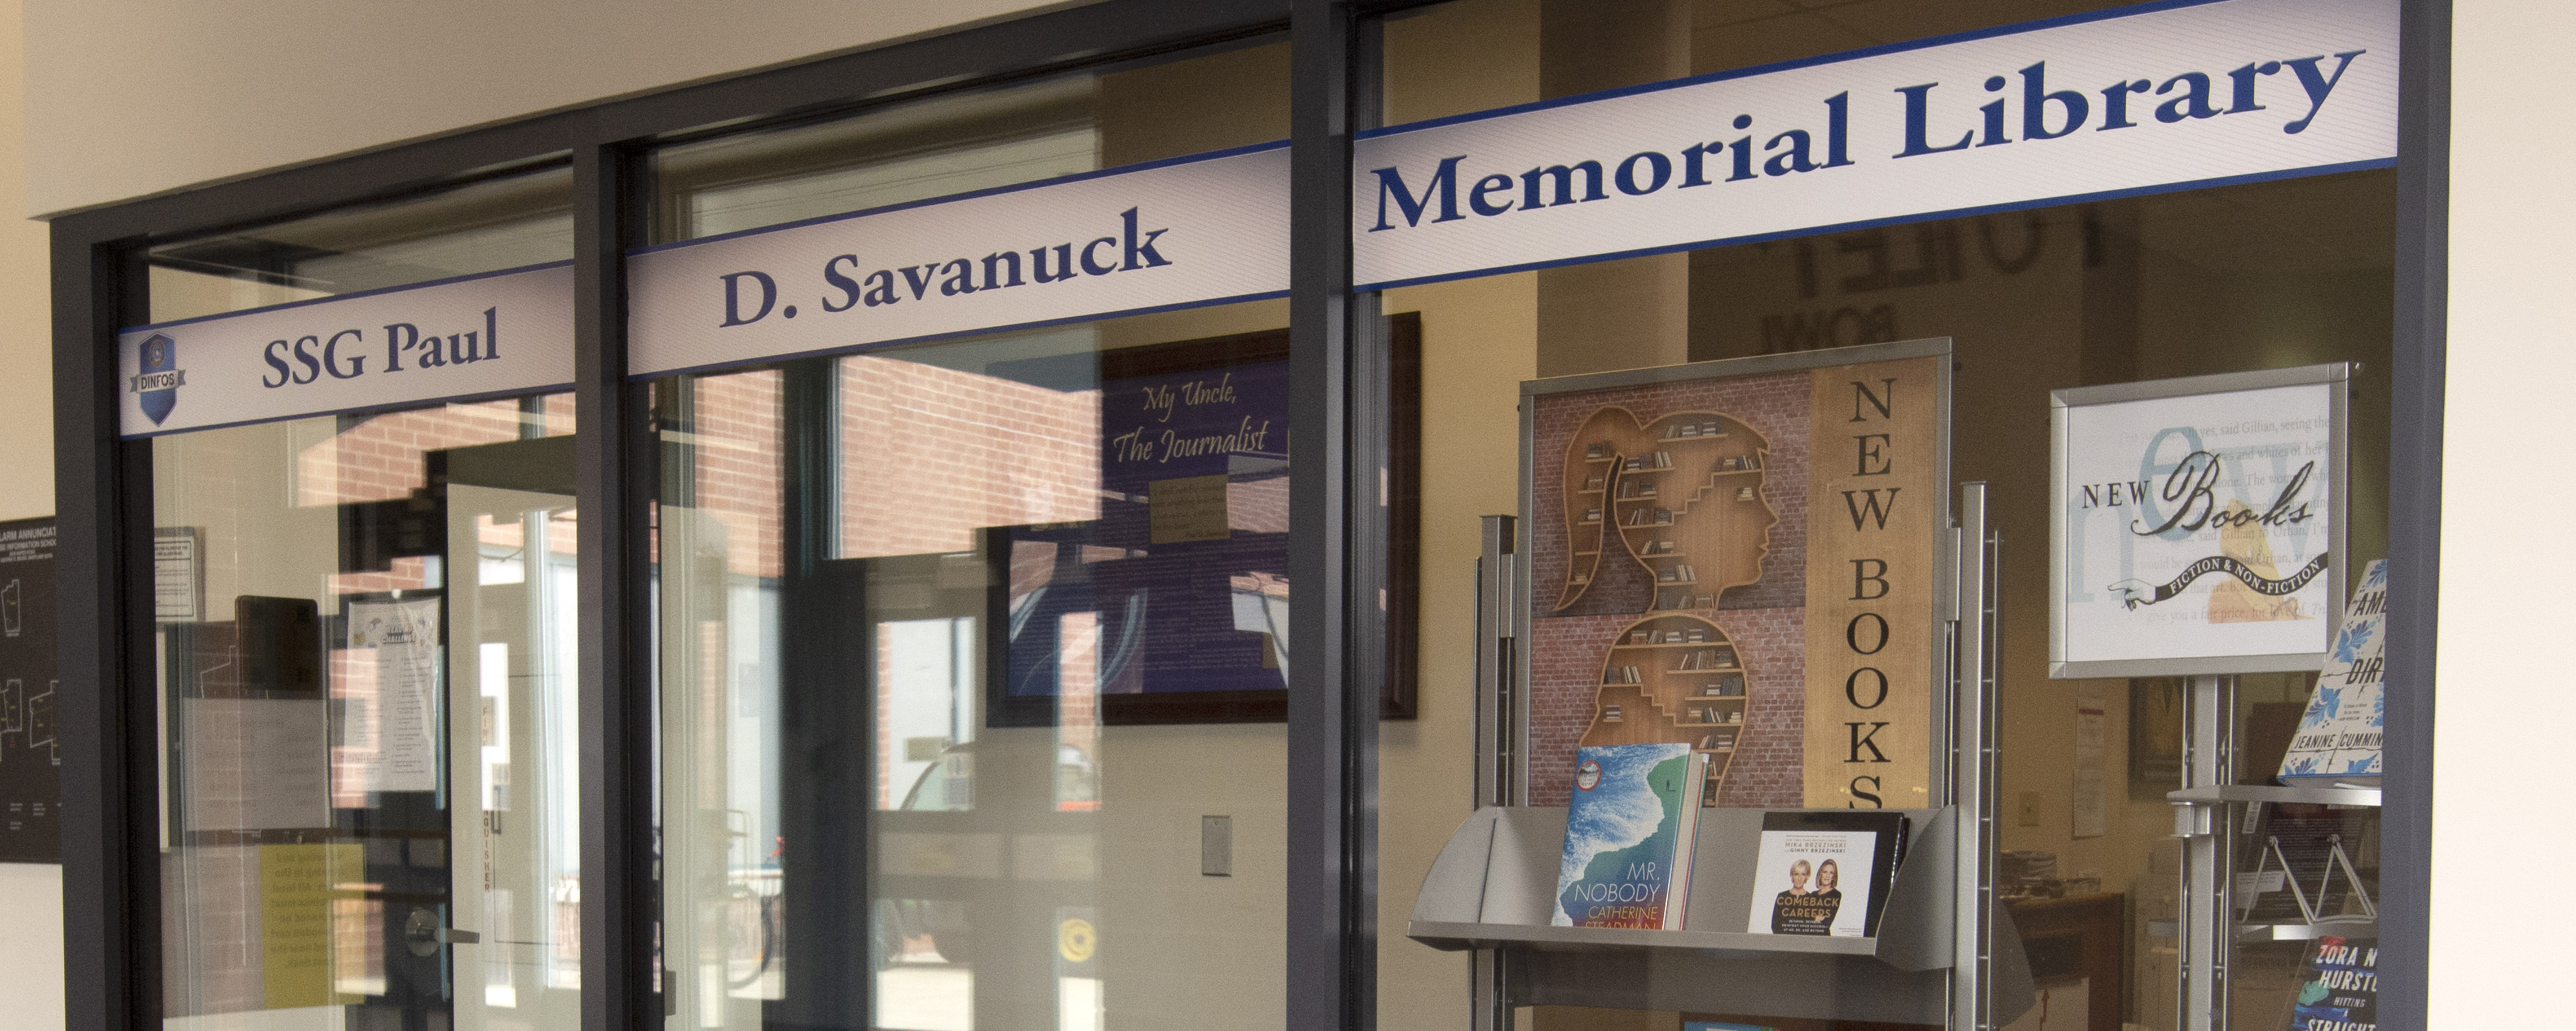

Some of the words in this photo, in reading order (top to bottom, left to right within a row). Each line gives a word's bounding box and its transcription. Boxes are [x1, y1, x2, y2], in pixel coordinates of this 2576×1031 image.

[1368, 90, 1856, 233] Memorial
[1892, 49, 2367, 158] Library
[719, 271, 797, 327] D.
[821, 205, 1173, 314] Savanuck
[262, 329, 367, 389] SSG
[383, 306, 500, 374] Paul
[141, 373, 175, 389] DINFOS
[1143, 384, 1175, 422] My
[1183, 373, 1236, 406] Uncle,
[2220, 423, 2239, 436] said
[2242, 419, 2279, 435] Gillian,
[2280, 417, 2312, 433] seeing
[1113, 426, 1153, 463] The
[1159, 415, 1269, 464] Journalist
[1840, 378, 1901, 533] NEW
[2082, 481, 2150, 509] NEW
[2131, 451, 2314, 536] Books
[2222, 526, 2255, 541] Gillian
[2169, 559, 2220, 594] FICTION
[2224, 559, 2232, 572] &
[2235, 559, 2321, 593] NON-FICTION
[2346, 657, 2385, 684] DIR
[1843, 558, 1892, 809] BOOKS
[2295, 733, 2335, 749] JEANINE
[1627, 862, 1660, 880] MR.
[1574, 883, 1660, 902] NOBODY
[1776, 896, 1839, 906] COMEBACK
[1588, 906, 1658, 920] CATHERINE
[1781, 907, 1831, 918] CAREERS
[2316, 945, 2359, 966] ZORA
[2334, 997, 2366, 1008] HITTING
